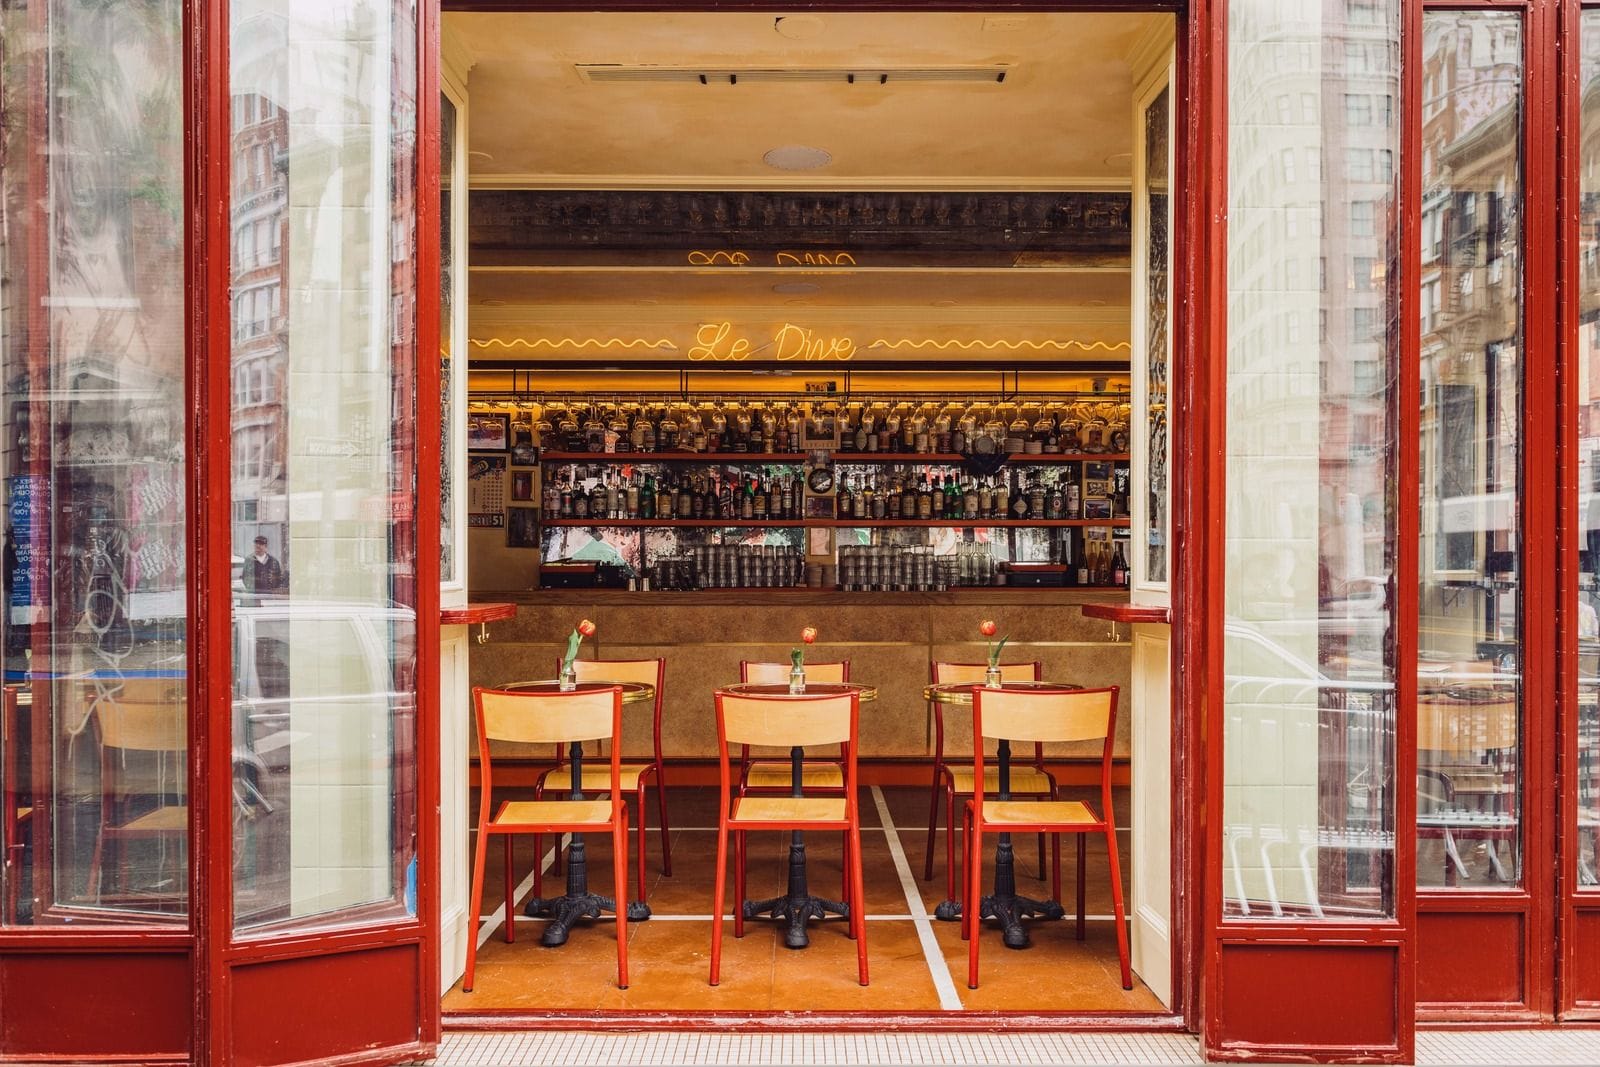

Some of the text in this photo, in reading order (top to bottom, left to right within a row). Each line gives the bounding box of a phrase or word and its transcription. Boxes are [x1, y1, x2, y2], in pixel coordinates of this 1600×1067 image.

[688, 322, 857, 361] Le Dive
[492, 515, 503, 526] 51
